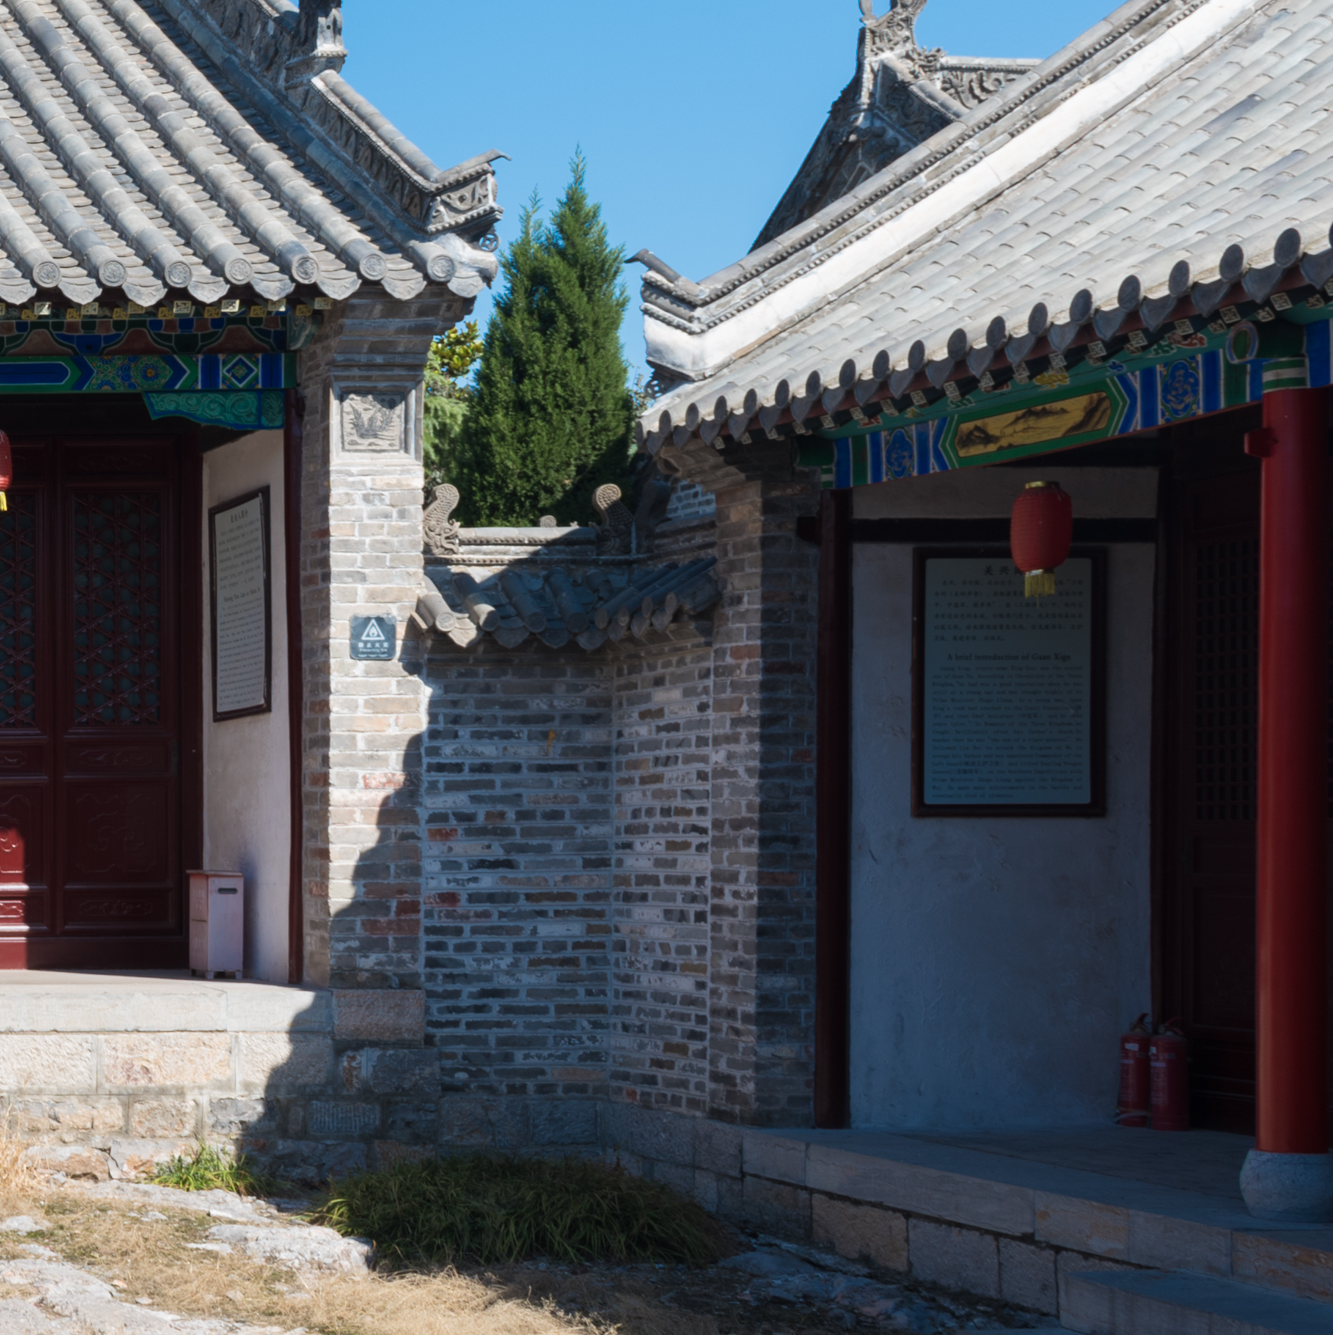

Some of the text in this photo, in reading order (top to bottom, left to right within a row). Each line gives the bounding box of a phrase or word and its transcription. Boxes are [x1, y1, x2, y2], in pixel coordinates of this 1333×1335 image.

[955, 653, 972, 661] brief
[974, 653, 1020, 661] introduction
[1021, 653, 1031, 661] of
